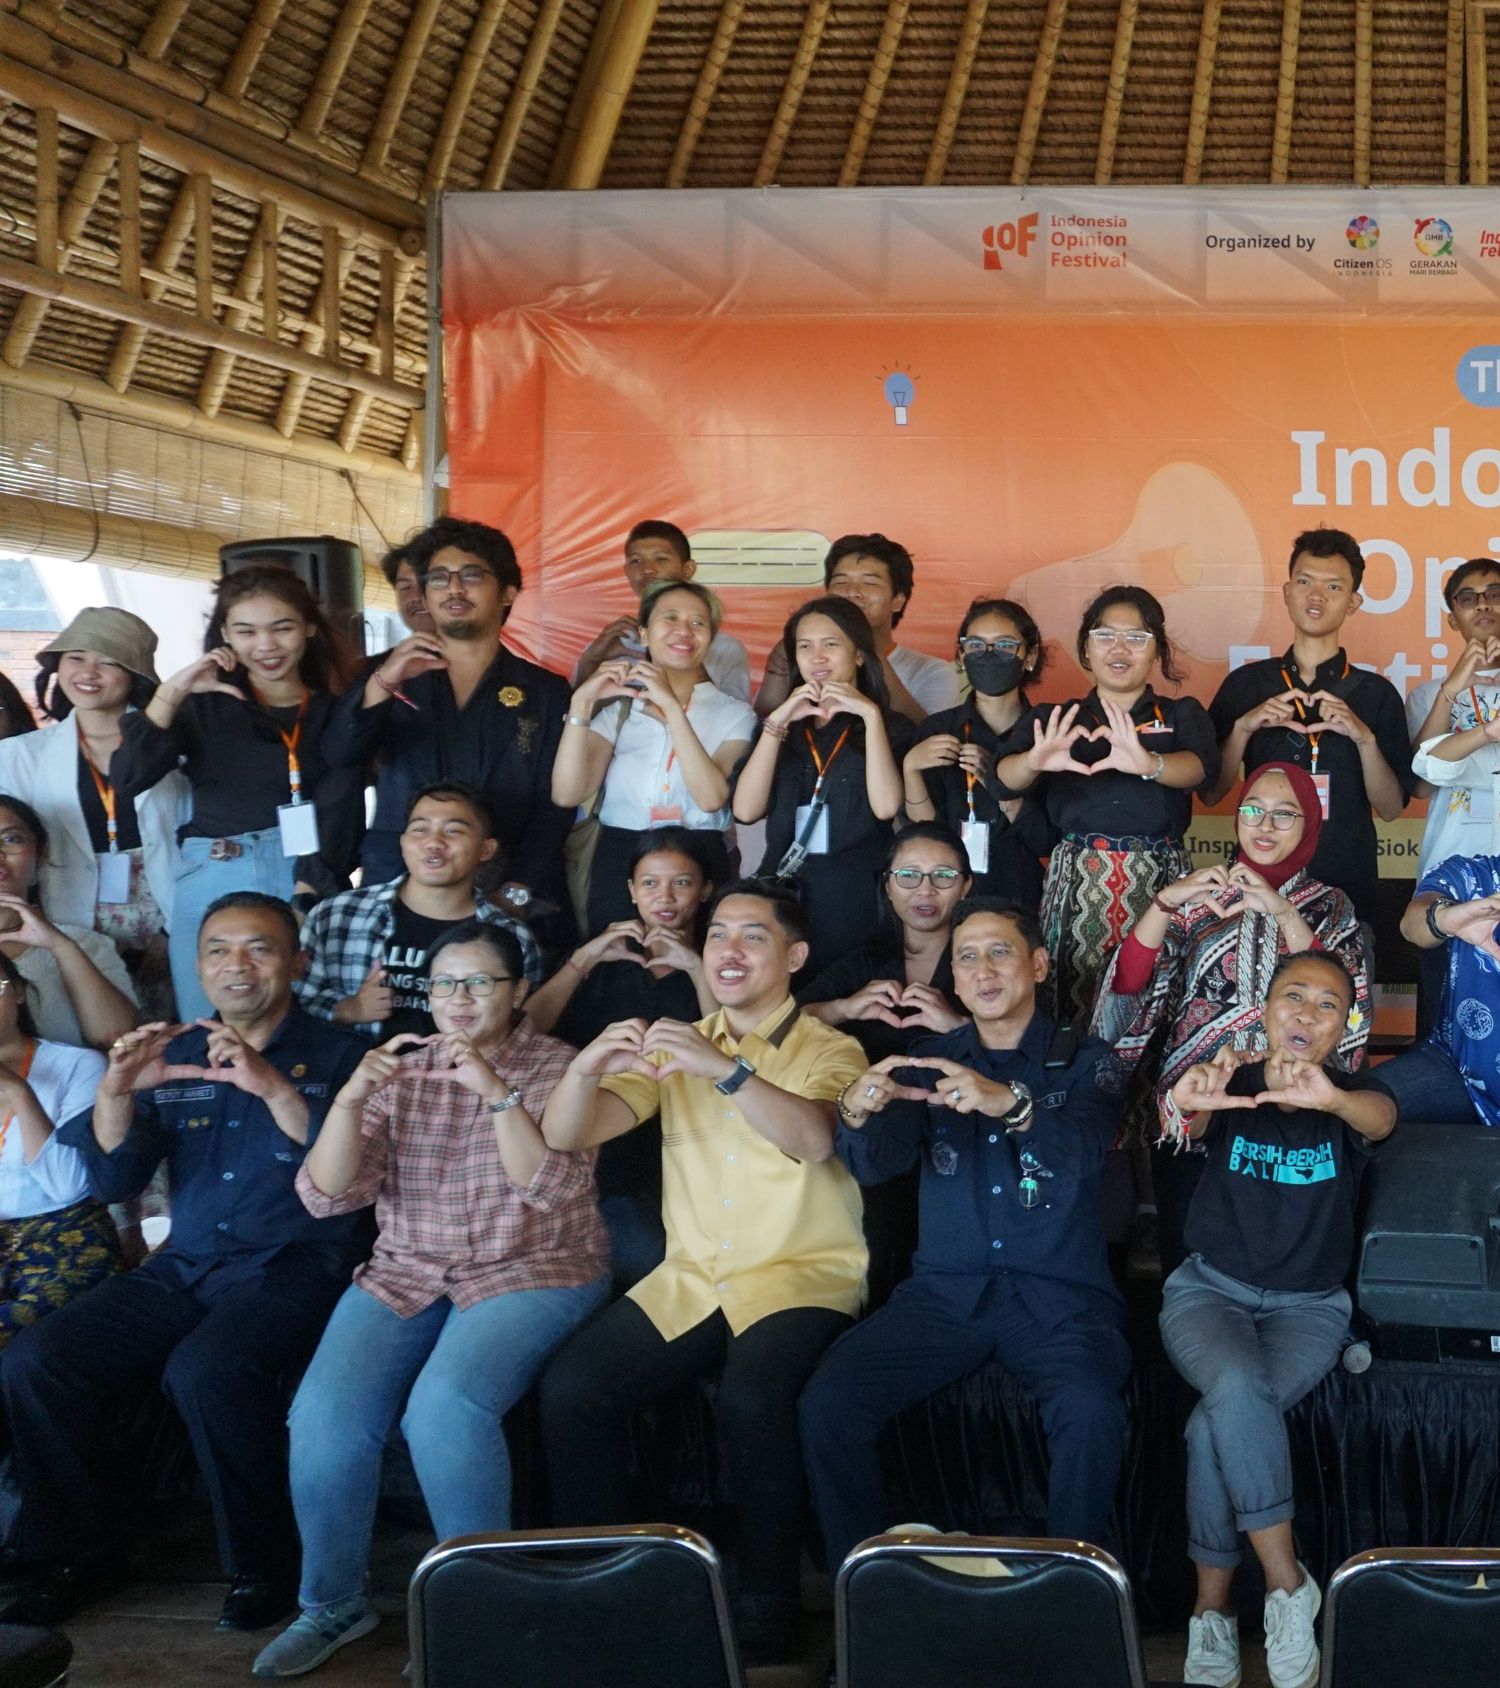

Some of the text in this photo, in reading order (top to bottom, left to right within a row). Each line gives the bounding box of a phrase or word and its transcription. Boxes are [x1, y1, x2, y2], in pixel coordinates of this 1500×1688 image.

[1051, 215, 1127, 227] Indonesia
[1051, 232, 1126, 249] Opinion
[1206, 235, 1315, 252] Organized by
[1425, 233, 1443, 241] GMB
[1051, 252, 1126, 267] Festival
[1334, 259, 1392, 269] Citizen OS
[1410, 260, 1457, 268] GERAKAN
[1232, 1135, 1333, 1167] BERSIH-BERSIH
[1229, 1153, 1278, 1182] BALI
